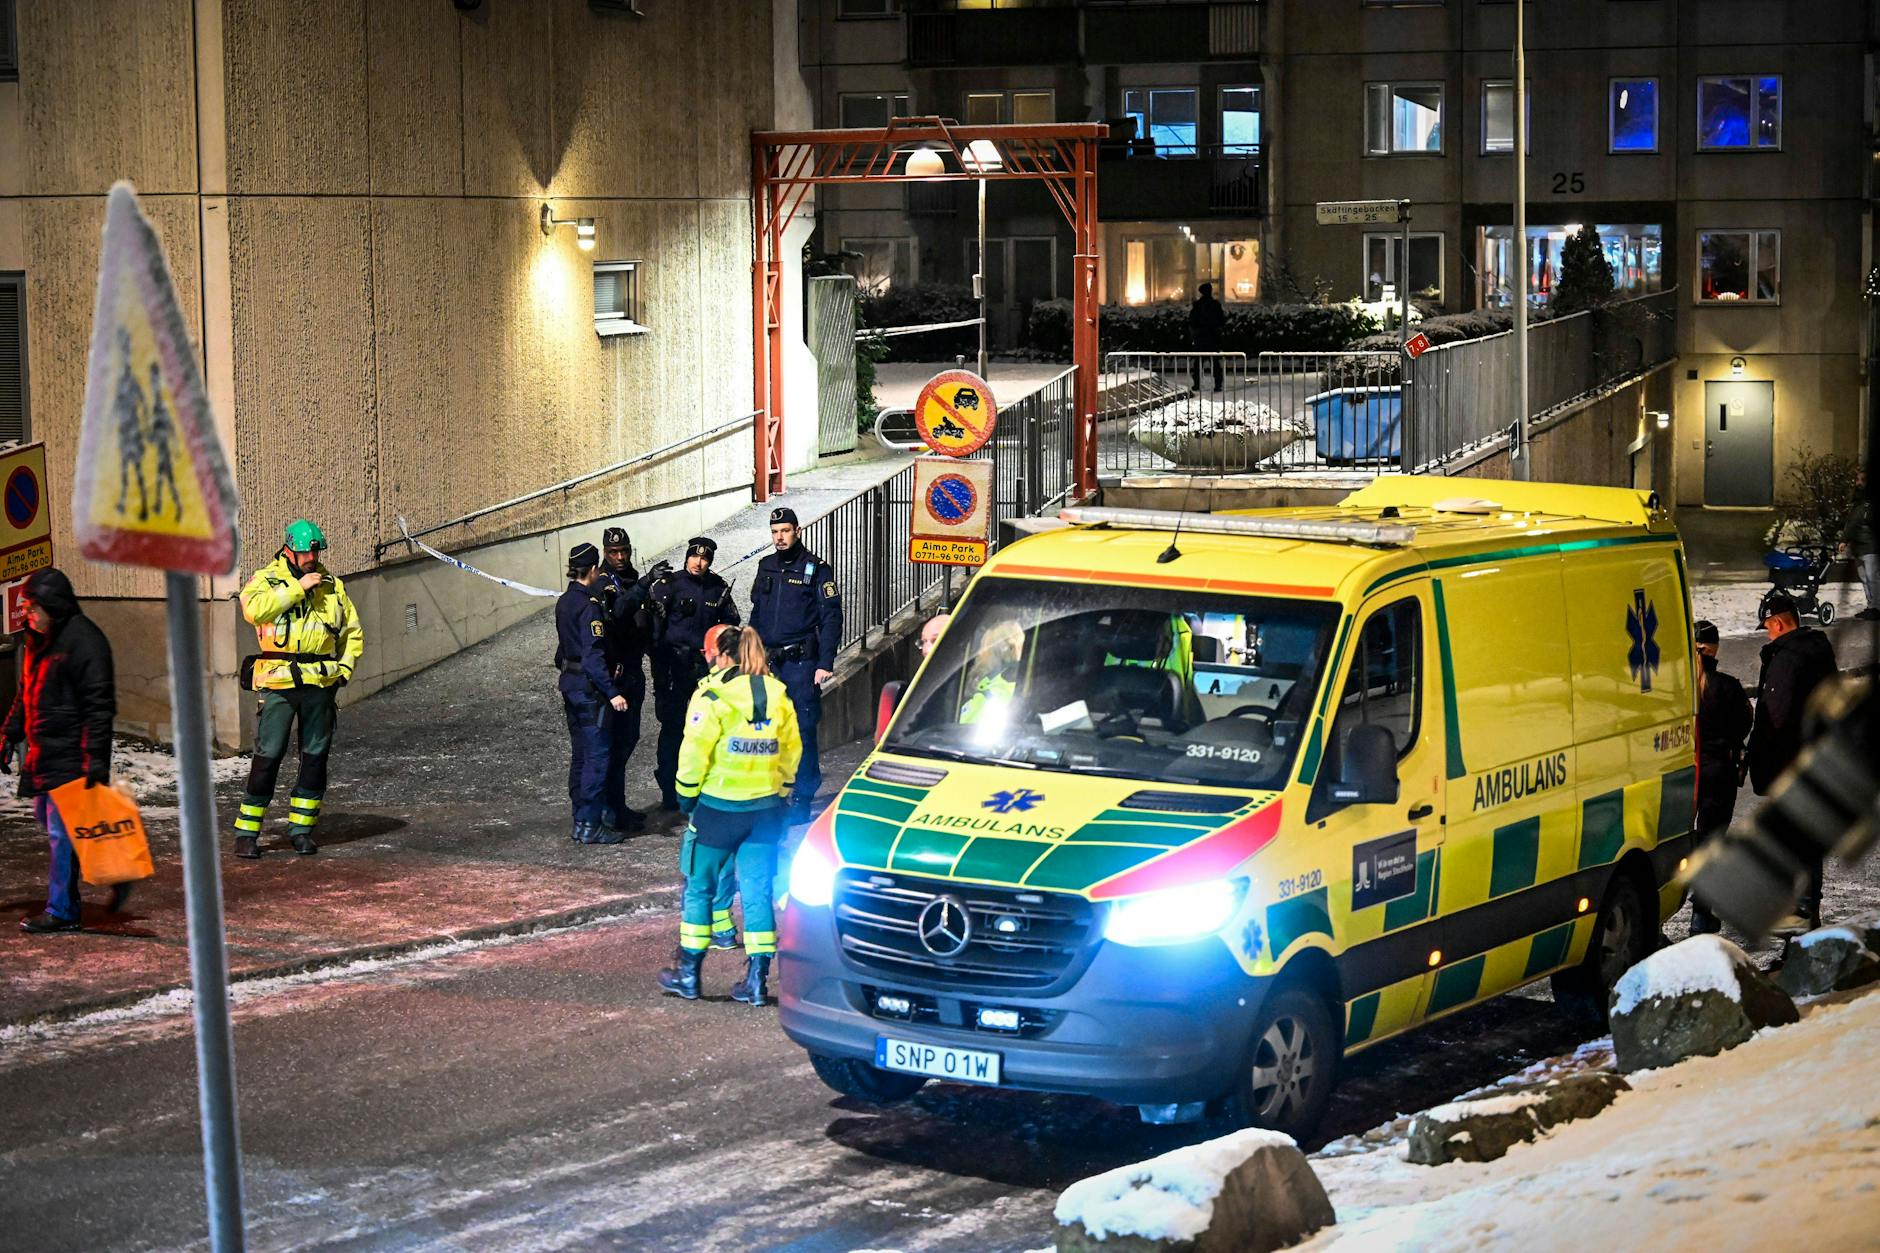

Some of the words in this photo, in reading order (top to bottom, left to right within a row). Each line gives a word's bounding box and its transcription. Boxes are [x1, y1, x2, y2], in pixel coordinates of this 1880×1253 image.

[1552, 172, 1585, 194] 25
[1365, 213, 1377, 221] 25
[7, 553, 25, 565] Aimo
[28, 546, 44, 559] Park
[915, 551, 951, 561] 0771-96
[954, 554, 965, 562] 90
[967, 555, 980, 563] 00
[922, 542, 948, 552] Aimo
[951, 544, 974, 553] Park
[3, 562, 29, 578] 0771-96
[30, 559, 38, 570] 90
[40, 555, 49, 567] 00
[1186, 744, 1261, 763] 331-9120
[1473, 752, 1566, 812] AMBULANS
[912, 813, 1065, 839] AMBULANS
[1278, 869, 1322, 899] 331-9120
[895, 1044, 936, 1070] SNP
[944, 1052, 989, 1078] 01W
